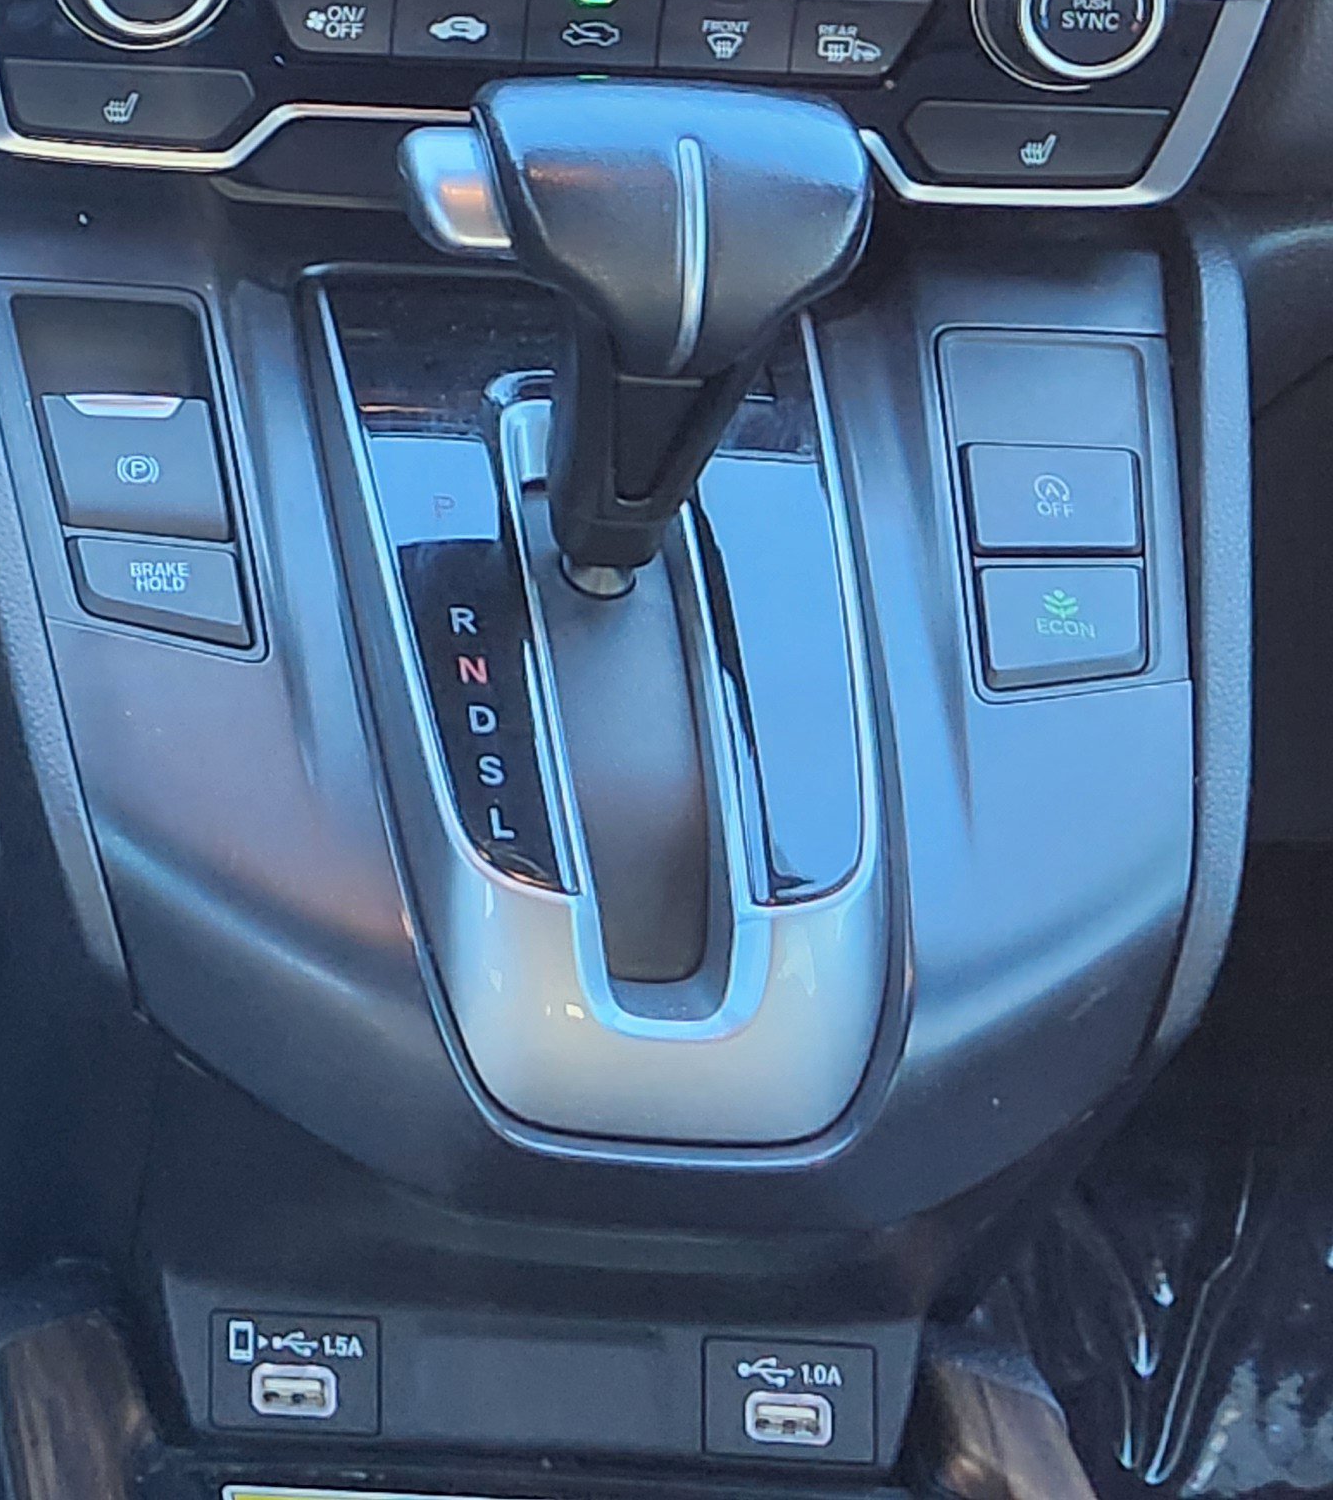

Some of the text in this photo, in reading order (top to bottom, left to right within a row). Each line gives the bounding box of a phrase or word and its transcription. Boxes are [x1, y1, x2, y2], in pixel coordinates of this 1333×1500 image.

[326, 5, 367, 22] ON/
[1061, 10, 1120, 31] SYNC
[325, 21, 364, 40] OFF
[702, 18, 751, 34] FRONT
[818, 23, 857, 37] REAR
[1036, 500, 1073, 519] OFF
[130, 561, 189, 579] BRAKE
[135, 575, 186, 593] HOLD
[449, 606, 476, 635] R
[1035, 619, 1096, 639] ECON
[458, 655, 488, 685] N
[469, 706, 496, 734] D
[479, 757, 505, 786] S
[489, 808, 515, 840] L
[800, 1364, 843, 1387] 1.0A
